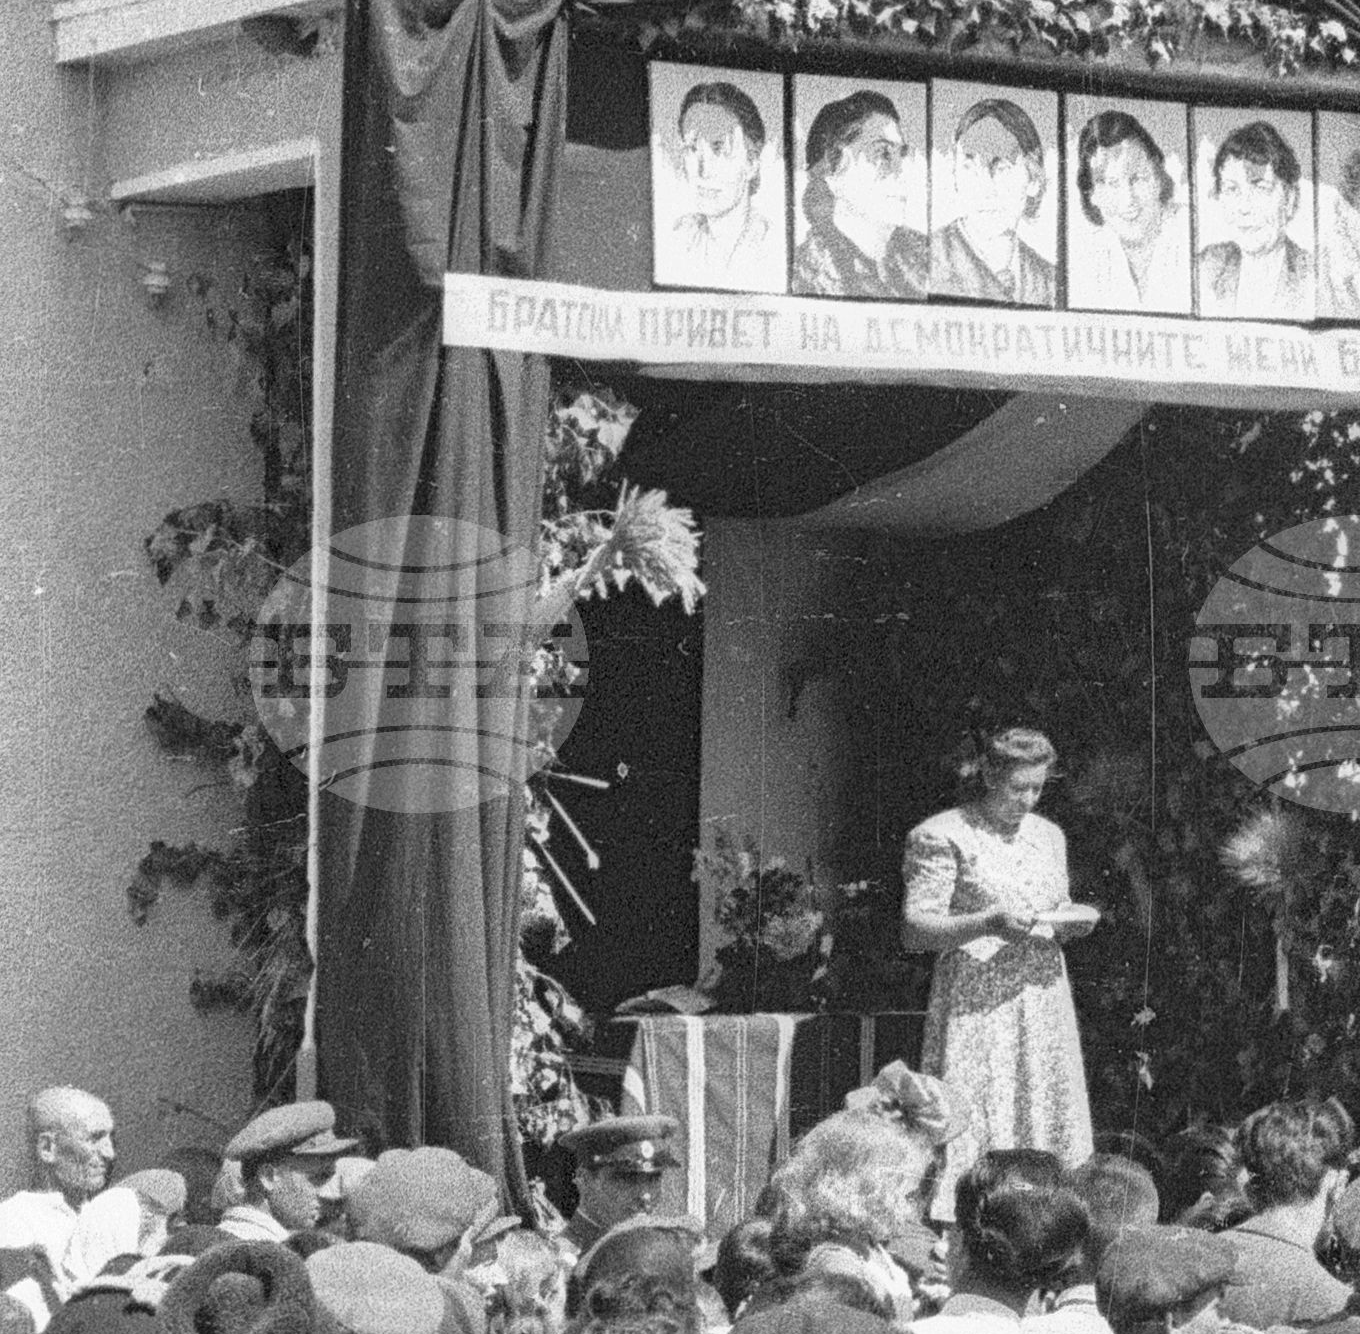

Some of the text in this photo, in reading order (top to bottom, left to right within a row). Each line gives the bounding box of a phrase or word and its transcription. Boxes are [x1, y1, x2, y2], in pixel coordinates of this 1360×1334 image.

[486, 288, 626, 344] БРАТСКИ
[638, 307, 779, 349] ПРИВЕТ
[800, 312, 843, 353] НА
[864, 315, 1207, 371] ДЕМОКРАТИЧНИТЕ
